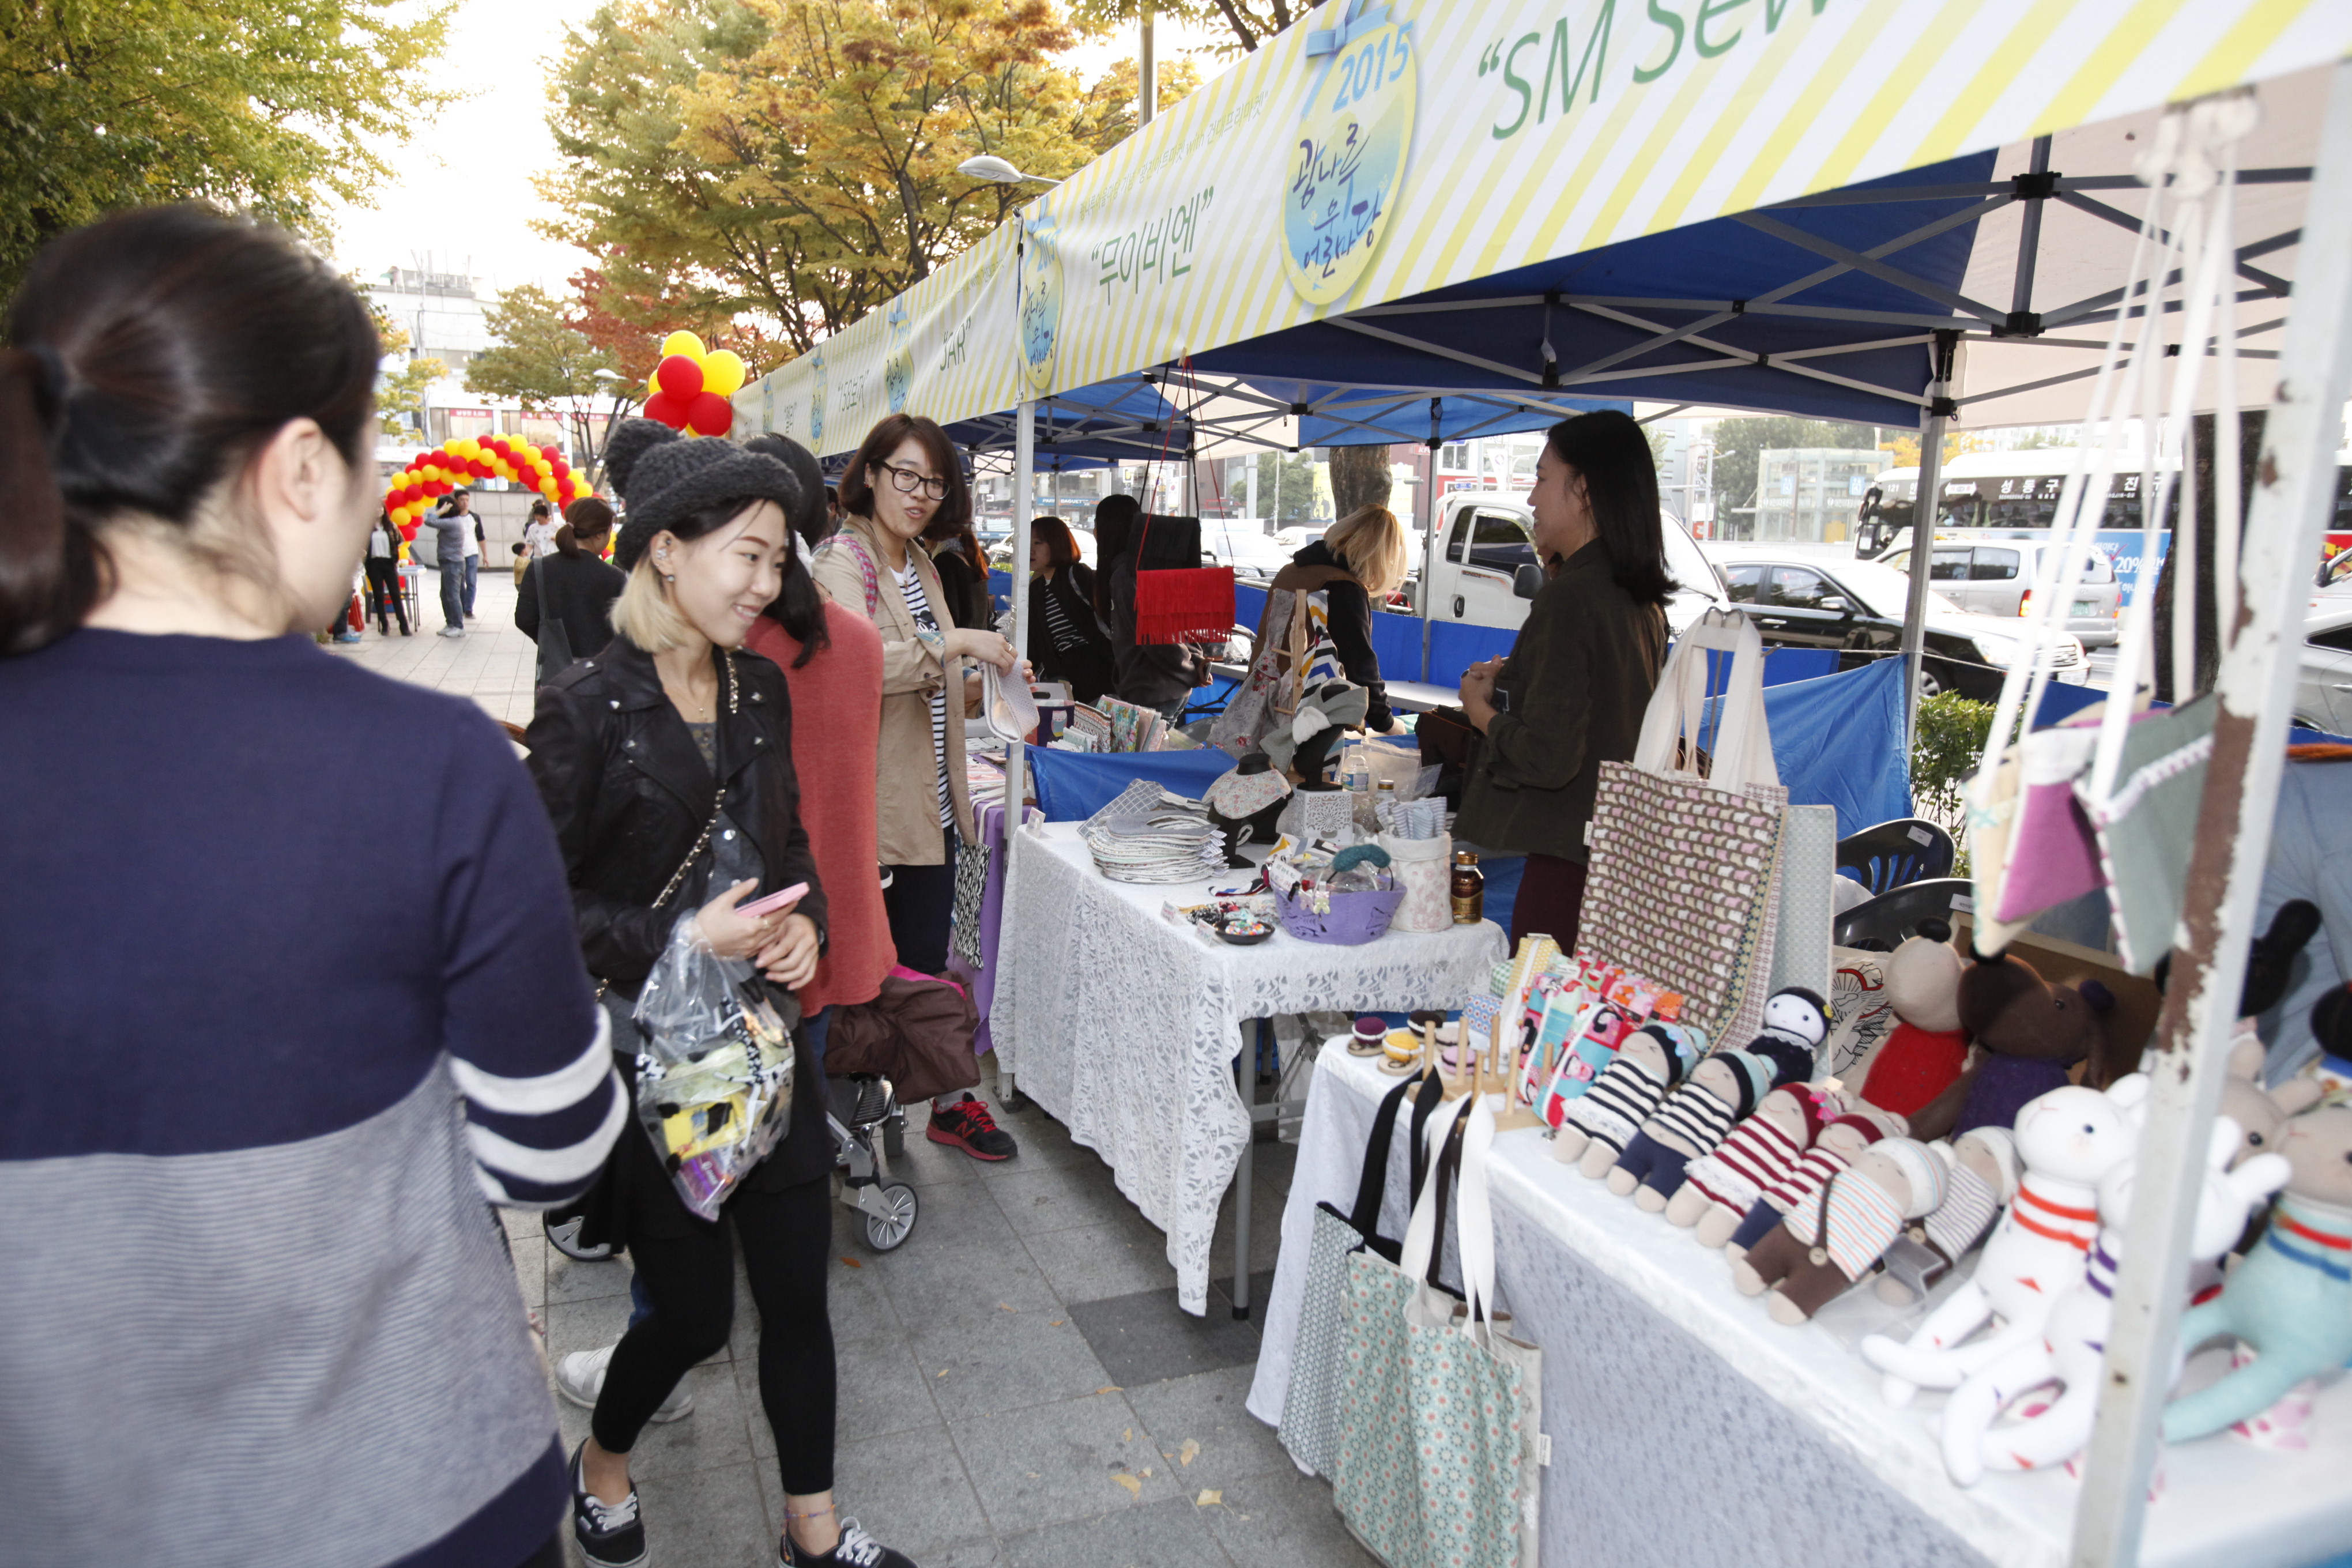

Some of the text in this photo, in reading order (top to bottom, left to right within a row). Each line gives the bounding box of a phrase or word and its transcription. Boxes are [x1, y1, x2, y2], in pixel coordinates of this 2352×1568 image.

[1332, 20, 1414, 113] 2015
[1186, 131, 1204, 154] with
[1292, 123, 1370, 210] 광나루
[1037, 228, 1062, 273] 2015
[1888, 484, 1899, 492] 121
[2001, 479, 2059, 494] 성동구
